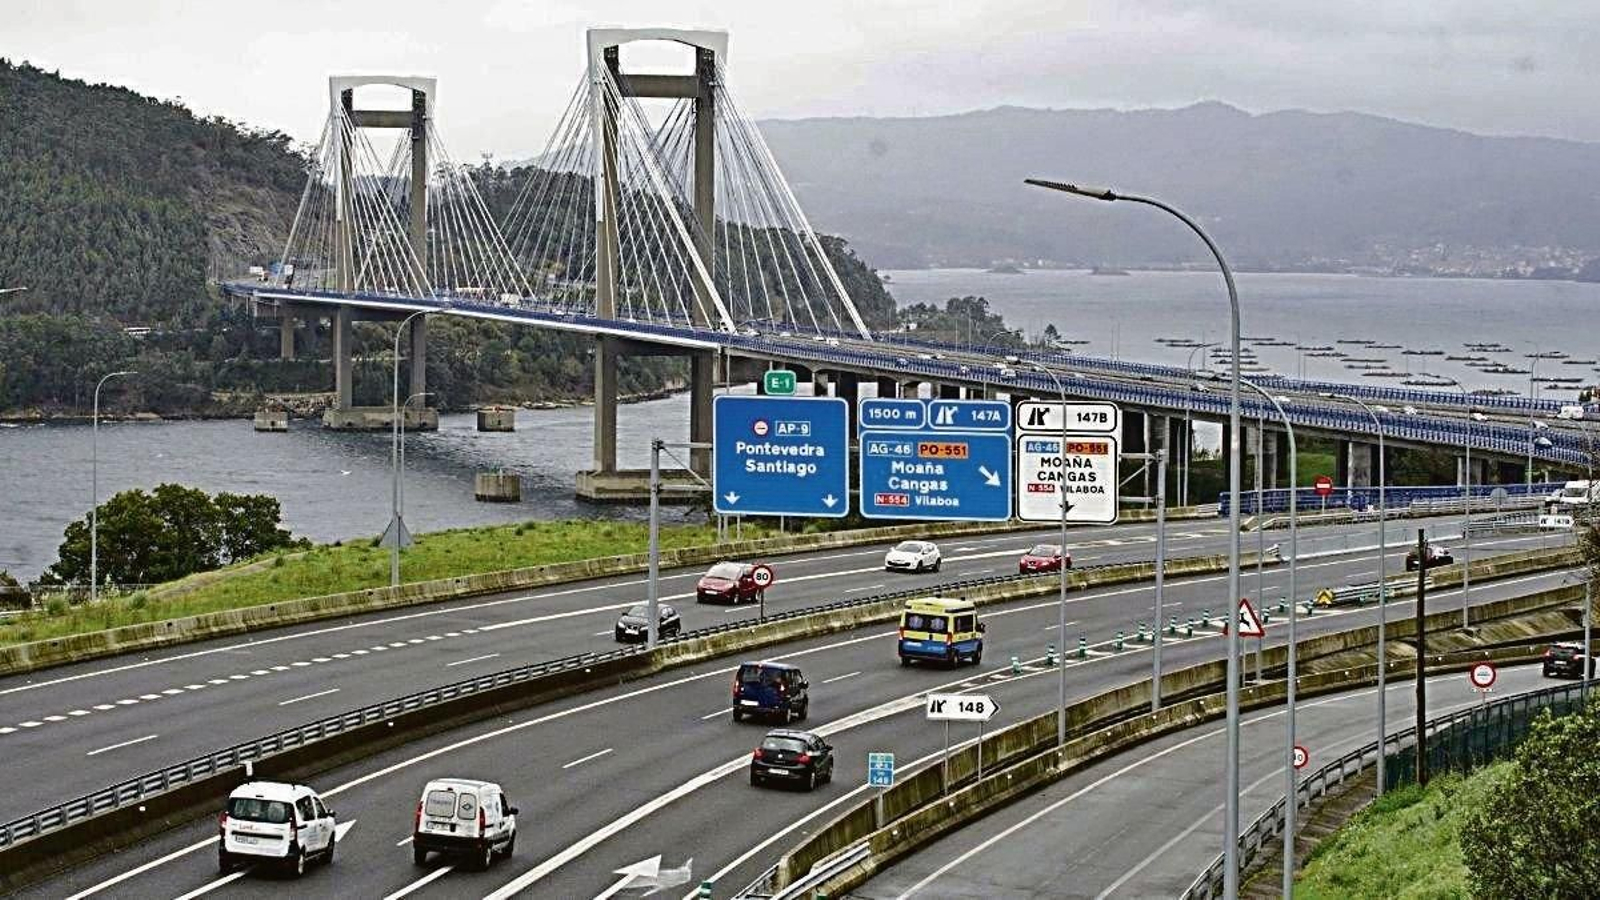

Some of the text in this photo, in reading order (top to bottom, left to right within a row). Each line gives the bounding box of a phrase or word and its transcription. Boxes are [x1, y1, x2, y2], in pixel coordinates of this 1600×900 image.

[771, 377, 790, 388] E-1
[868, 408, 917, 419] 1500 m
[971, 410, 1002, 421] 147A
[1077, 413, 1108, 423] 147B
[778, 423, 809, 434] AP-9
[735, 441, 825, 457] Pontevedra
[869, 443, 967, 456] AG-46 PO-551
[1040, 456, 1093, 468] MOAÑA
[745, 459, 817, 477] Santiago
[891, 461, 944, 475] Moaña
[1037, 471, 1097, 482] CANGAS
[888, 477, 949, 494] Cangas
[915, 495, 960, 506] Vilaboa
[756, 572, 769, 581] 80
[959, 702, 985, 714] 148
